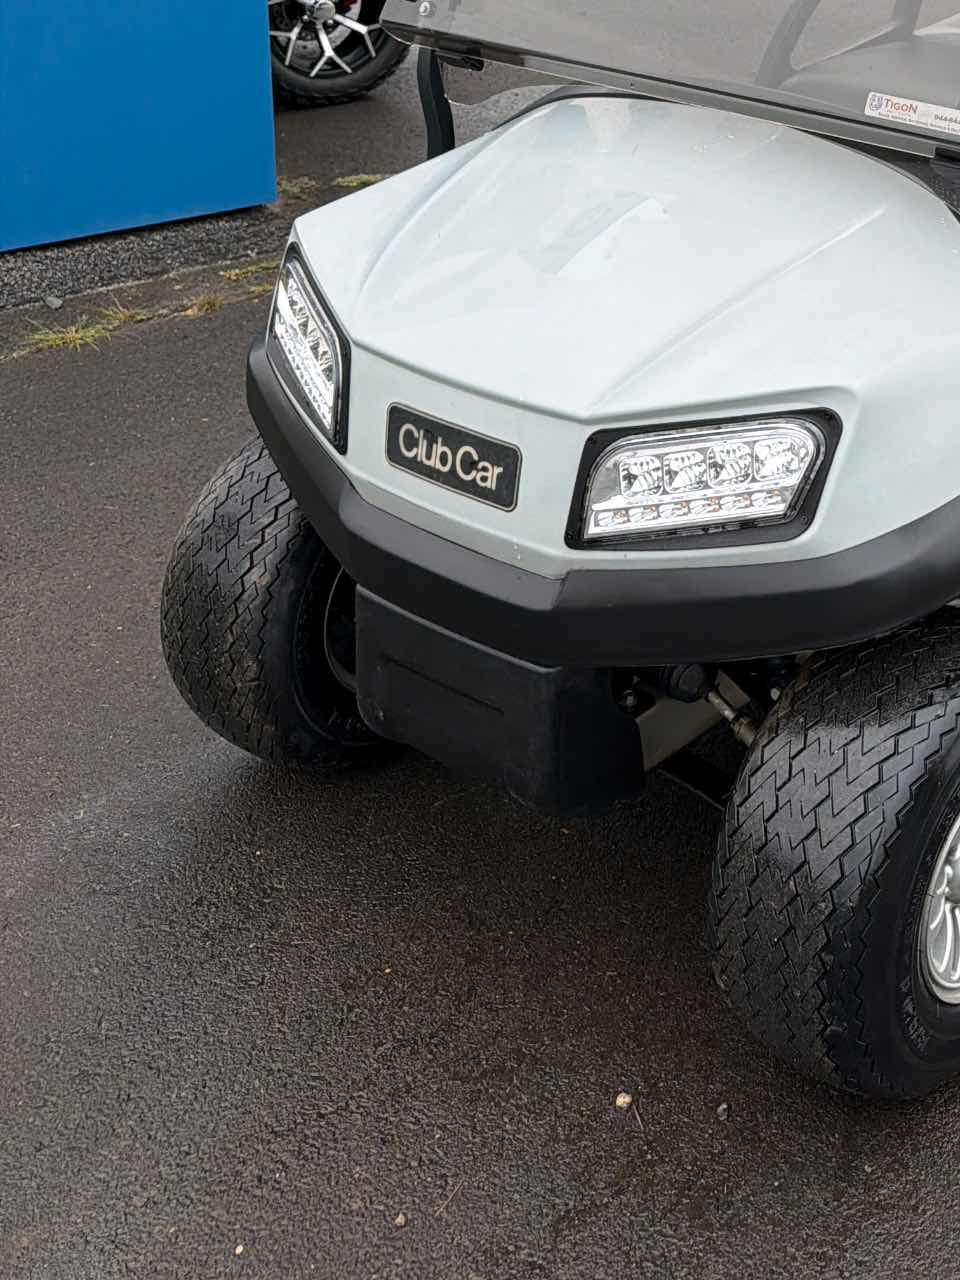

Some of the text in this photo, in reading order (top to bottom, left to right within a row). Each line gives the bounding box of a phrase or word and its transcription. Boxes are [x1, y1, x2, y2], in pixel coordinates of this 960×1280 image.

[884, 97, 919, 114] TIGON
[399, 423, 504, 490] Club Car
